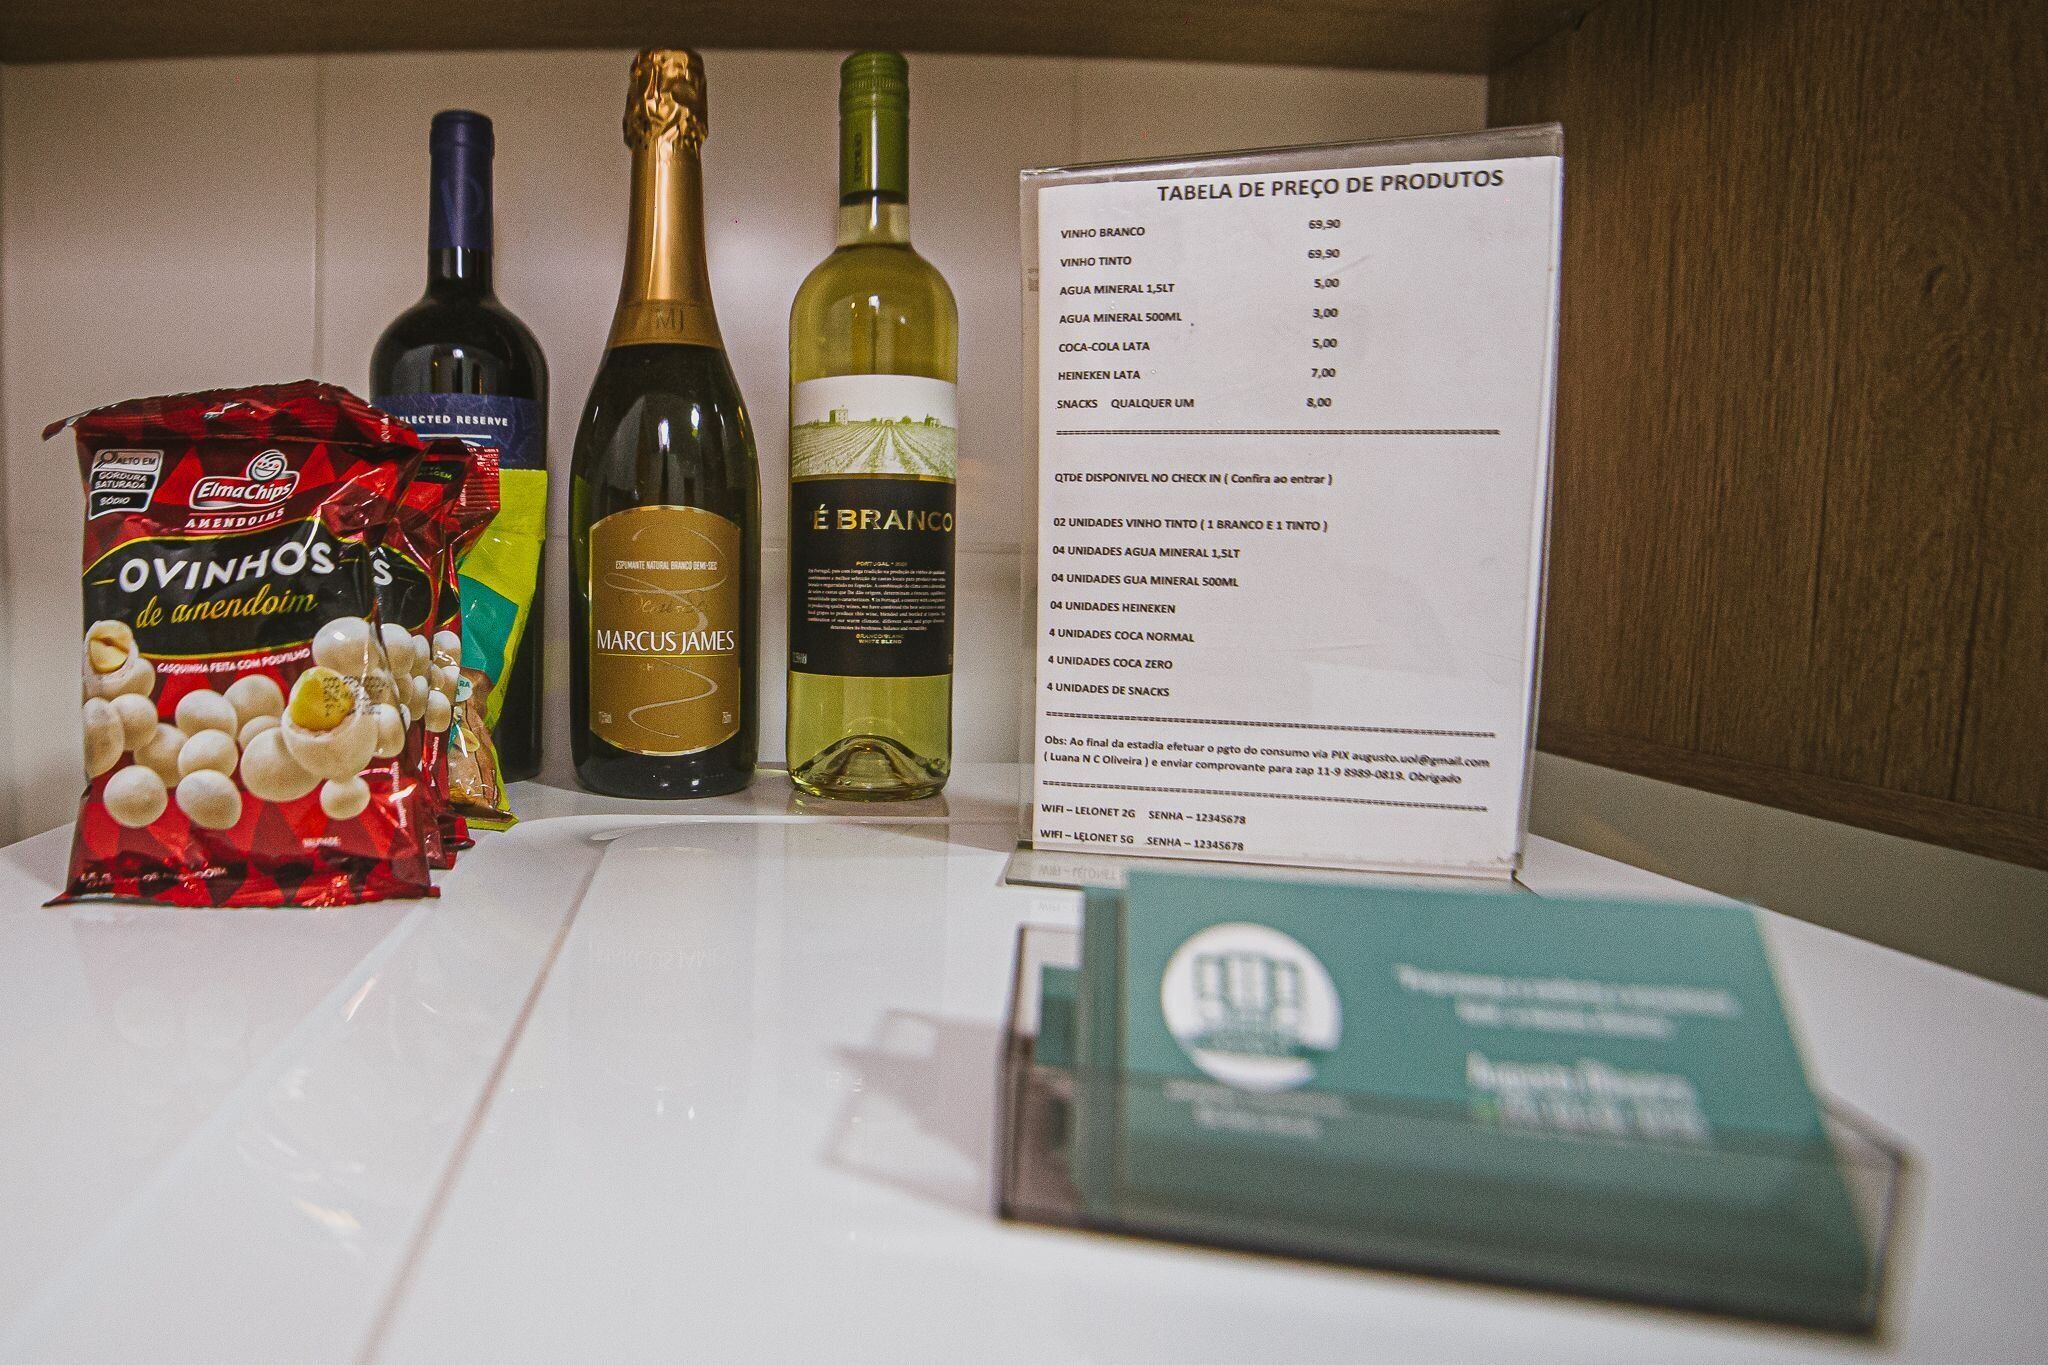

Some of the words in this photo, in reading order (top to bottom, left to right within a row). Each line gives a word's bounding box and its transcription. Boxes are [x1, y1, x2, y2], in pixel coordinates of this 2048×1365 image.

[1157, 183, 1233, 202] TABELA
[1238, 182, 1265, 198] DE
[1271, 178, 1340, 199] PREÇO
[1346, 177, 1374, 194] DE
[1380, 169, 1504, 192] PRODUTOS
[1060, 228, 1097, 239] VINHO
[1099, 226, 1146, 238] BRANCO
[1308, 219, 1341, 230] 69,90
[1060, 257, 1096, 268] VINHO
[1098, 256, 1132, 266] TINTO
[1307, 248, 1340, 260] 69,90
[1059, 285, 1092, 296] AGUA
[1093, 284, 1144, 294] MINERAL
[1146, 283, 1175, 295] 1,5LT
[1314, 278, 1340, 290] 5,00
[1059, 314, 1091, 324] AGUA
[1093, 313, 1144, 323] MINERAL
[1145, 312, 1183, 322] 500ML
[1312, 308, 1339, 320] 3,00
[1058, 342, 1120, 353] COCA-COLA
[1122, 341, 1150, 351] LATA
[1312, 338, 1338, 350] 5,00
[1058, 370, 1111, 381] HEINEKEN
[1113, 370, 1141, 380] LATA
[1311, 368, 1336, 379] 7,00
[1057, 399, 1098, 409] SNACKS
[1110, 398, 1172, 409] QUALQUER
[1174, 398, 1195, 408] UM
[1306, 397, 1332, 409] 8,00
[395, 415, 451, 425] ELECTED
[456, 415, 508, 427] RESERVE
[117, 456, 140, 465] ALTO
[142, 456, 156, 465] EM
[98, 471, 148, 482] GORDURA
[1054, 473, 1083, 483] QTDE
[1085, 473, 1150, 483] DISPONIVEL
[1151, 473, 1169, 483] NO
[1171, 473, 1207, 483] CHECK
[1209, 474, 1222, 483] IN
[1230, 473, 1271, 484] Confira
[1273, 476, 1288, 484] ao
[1290, 475, 1326, 484] entrar
[95, 480, 146, 490] SATURADA
[184, 507, 285, 529] AMENDOINS
[813, 503, 829, 530] É
[836, 509, 953, 533] BRANCO
[1053, 517, 1066, 527] 02
[1068, 518, 1124, 528] UNIDADES
[1125, 518, 1161, 528] VINHO
[1164, 519, 1198, 529] TINTO
[1207, 520, 1214, 529] 1
[1216, 519, 1264, 530] BRANCO
[1266, 520, 1274, 530] E
[1276, 521, 1283, 530] 1
[1285, 520, 1321, 531] TINTO
[1052, 545, 1066, 555] 04
[1067, 546, 1123, 556] UNIDADES
[1124, 547, 1157, 557] AGUA
[1159, 547, 1209, 558] MINERAL
[1211, 548, 1241, 560] 1,5LT
[119, 541, 336, 593] OVINHOS
[615, 560, 646, 570] ESPUMANTE
[646, 560, 670, 570] NATURAL
[1051, 573, 1064, 582] 04
[1066, 574, 1121, 585] UNIDADES
[1123, 575, 1148, 585] GUA
[1150, 575, 1200, 586] MINERAL
[1202, 577, 1239, 587] 500ML
[136, 595, 163, 629] de
[170, 583, 319, 625] amendoim
[1050, 600, 1063, 610] 04
[1065, 601, 1120, 612] UNIDADES
[1122, 603, 1176, 614] HEINEKEN
[597, 629, 677, 651] MARCUS
[680, 630, 735, 655] JAMES
[1049, 628, 1056, 637] 4
[1057, 628, 1112, 640] UNIDADES
[1114, 630, 1144, 641] COCA
[1146, 632, 1195, 643] NORMAL
[157, 662, 209, 676] CASQUINHA
[209, 662, 237, 673] FEITA
[237, 658, 262, 671] COM
[261, 647, 311, 667] POLVILHO
[1047, 655, 1054, 664] 4
[1056, 655, 1111, 667] UNIDADES
[1113, 658, 1143, 668] COCA
[1144, 659, 1173, 670] ZERO
[1046, 682, 1053, 691] 4
[1055, 682, 1109, 694] UNIDADES
[1111, 685, 1126, 695] DE
[1128, 686, 1170, 697] SNACKS
[1044, 735, 1067, 746] Obs:
[1069, 737, 1084, 747] Ao
[1086, 737, 1109, 748] final
[1111, 739, 1124, 748] da
[1126, 740, 1164, 750] estadia
[1166, 741, 1205, 752] efetuar
[1207, 745, 1215, 753] o
[1216, 745, 1241, 756] pgto
[1243, 745, 1258, 755] do
[1260, 748, 1310, 758] consumo
[1312, 749, 1329, 759] via
[1331, 750, 1350, 760] PIX
[1351, 753, 1490, 768] augusto.uol@gmail.com
[1050, 752, 1080, 763] Luana
[1082, 754, 1090, 763] N
[1093, 754, 1100, 764] C
[1102, 755, 1142, 766] Oliveira
[1151, 759, 1158, 767] e
[1160, 758, 1193, 768] enviar
[1195, 761, 1266, 772] comprovante
[1268, 765, 1293, 775] para
[1295, 767, 1314, 777] zap
[1317, 766, 1342, 777] 11-9
[1408, 771, 1462, 785] Obrigado
[1041, 804, 1064, 813] WIFI
[1075, 806, 1120, 817] LELONET
[1121, 808, 1136, 818] 2G
[1148, 810, 1184, 821] SENHA
[1195, 813, 1246, 825] 12345678
[1040, 829, 1063, 839] WIFI
[1074, 831, 1118, 843] LELONET
[1120, 834, 1134, 844] 5G
[1146, 836, 1182, 847] SENHA
[1194, 839, 1244, 852] 12345678
